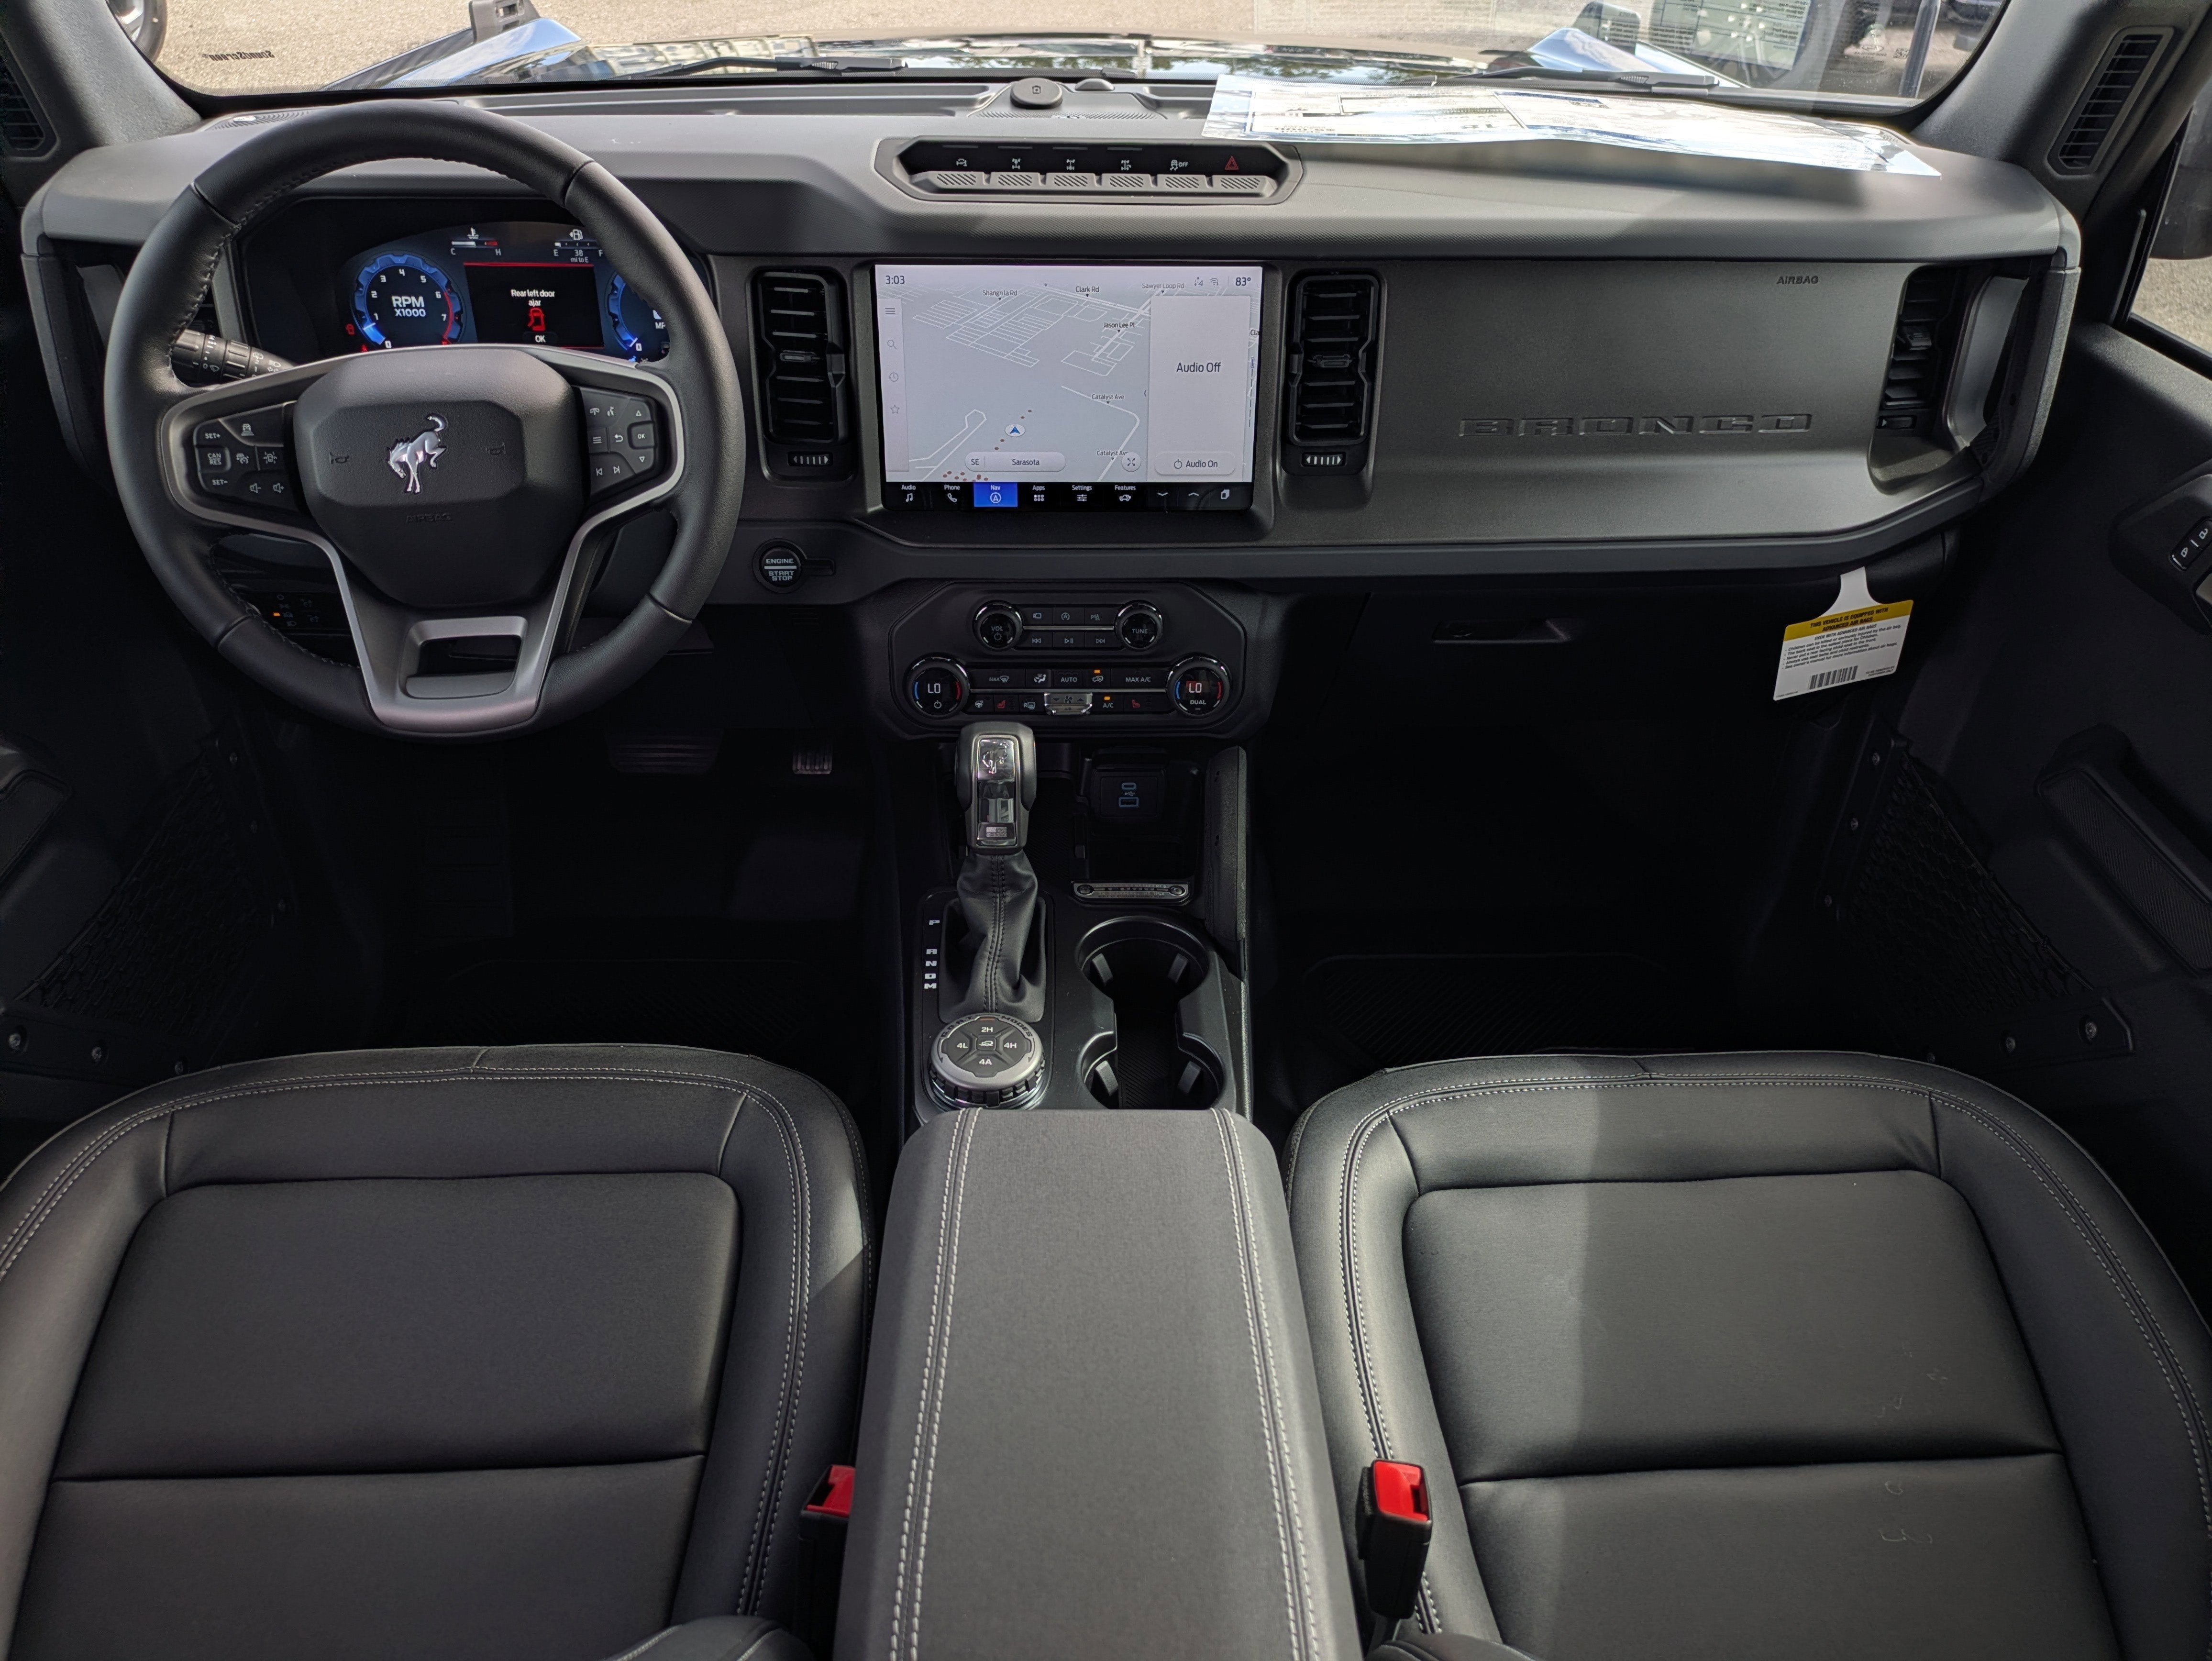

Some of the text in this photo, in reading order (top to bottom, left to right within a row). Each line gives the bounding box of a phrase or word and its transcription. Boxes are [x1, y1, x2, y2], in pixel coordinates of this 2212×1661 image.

[885, 275, 905, 285] 3:03
[1235, 277, 1251, 286] 83°
[1776, 276, 1819, 285] AIRBAG
[511, 289, 555, 297] Rear left door
[392, 296, 424, 308] RPM
[395, 309, 426, 317] X1000
[635, 343, 642, 351] 0
[1177, 362, 1221, 373] Audio Off
[1459, 413, 1812, 436] BRONCO
[1823, 616, 1843, 625] VEHICLE
[1850, 610, 1874, 620] EQUIPPED
[1822, 622, 1849, 632] ADVANCED
[1837, 628, 1858, 636] ADVANCED
[928, 683, 941, 694] LO
[1189, 683, 1202, 693] LO
[1001, 1016, 1033, 1037] MODES
